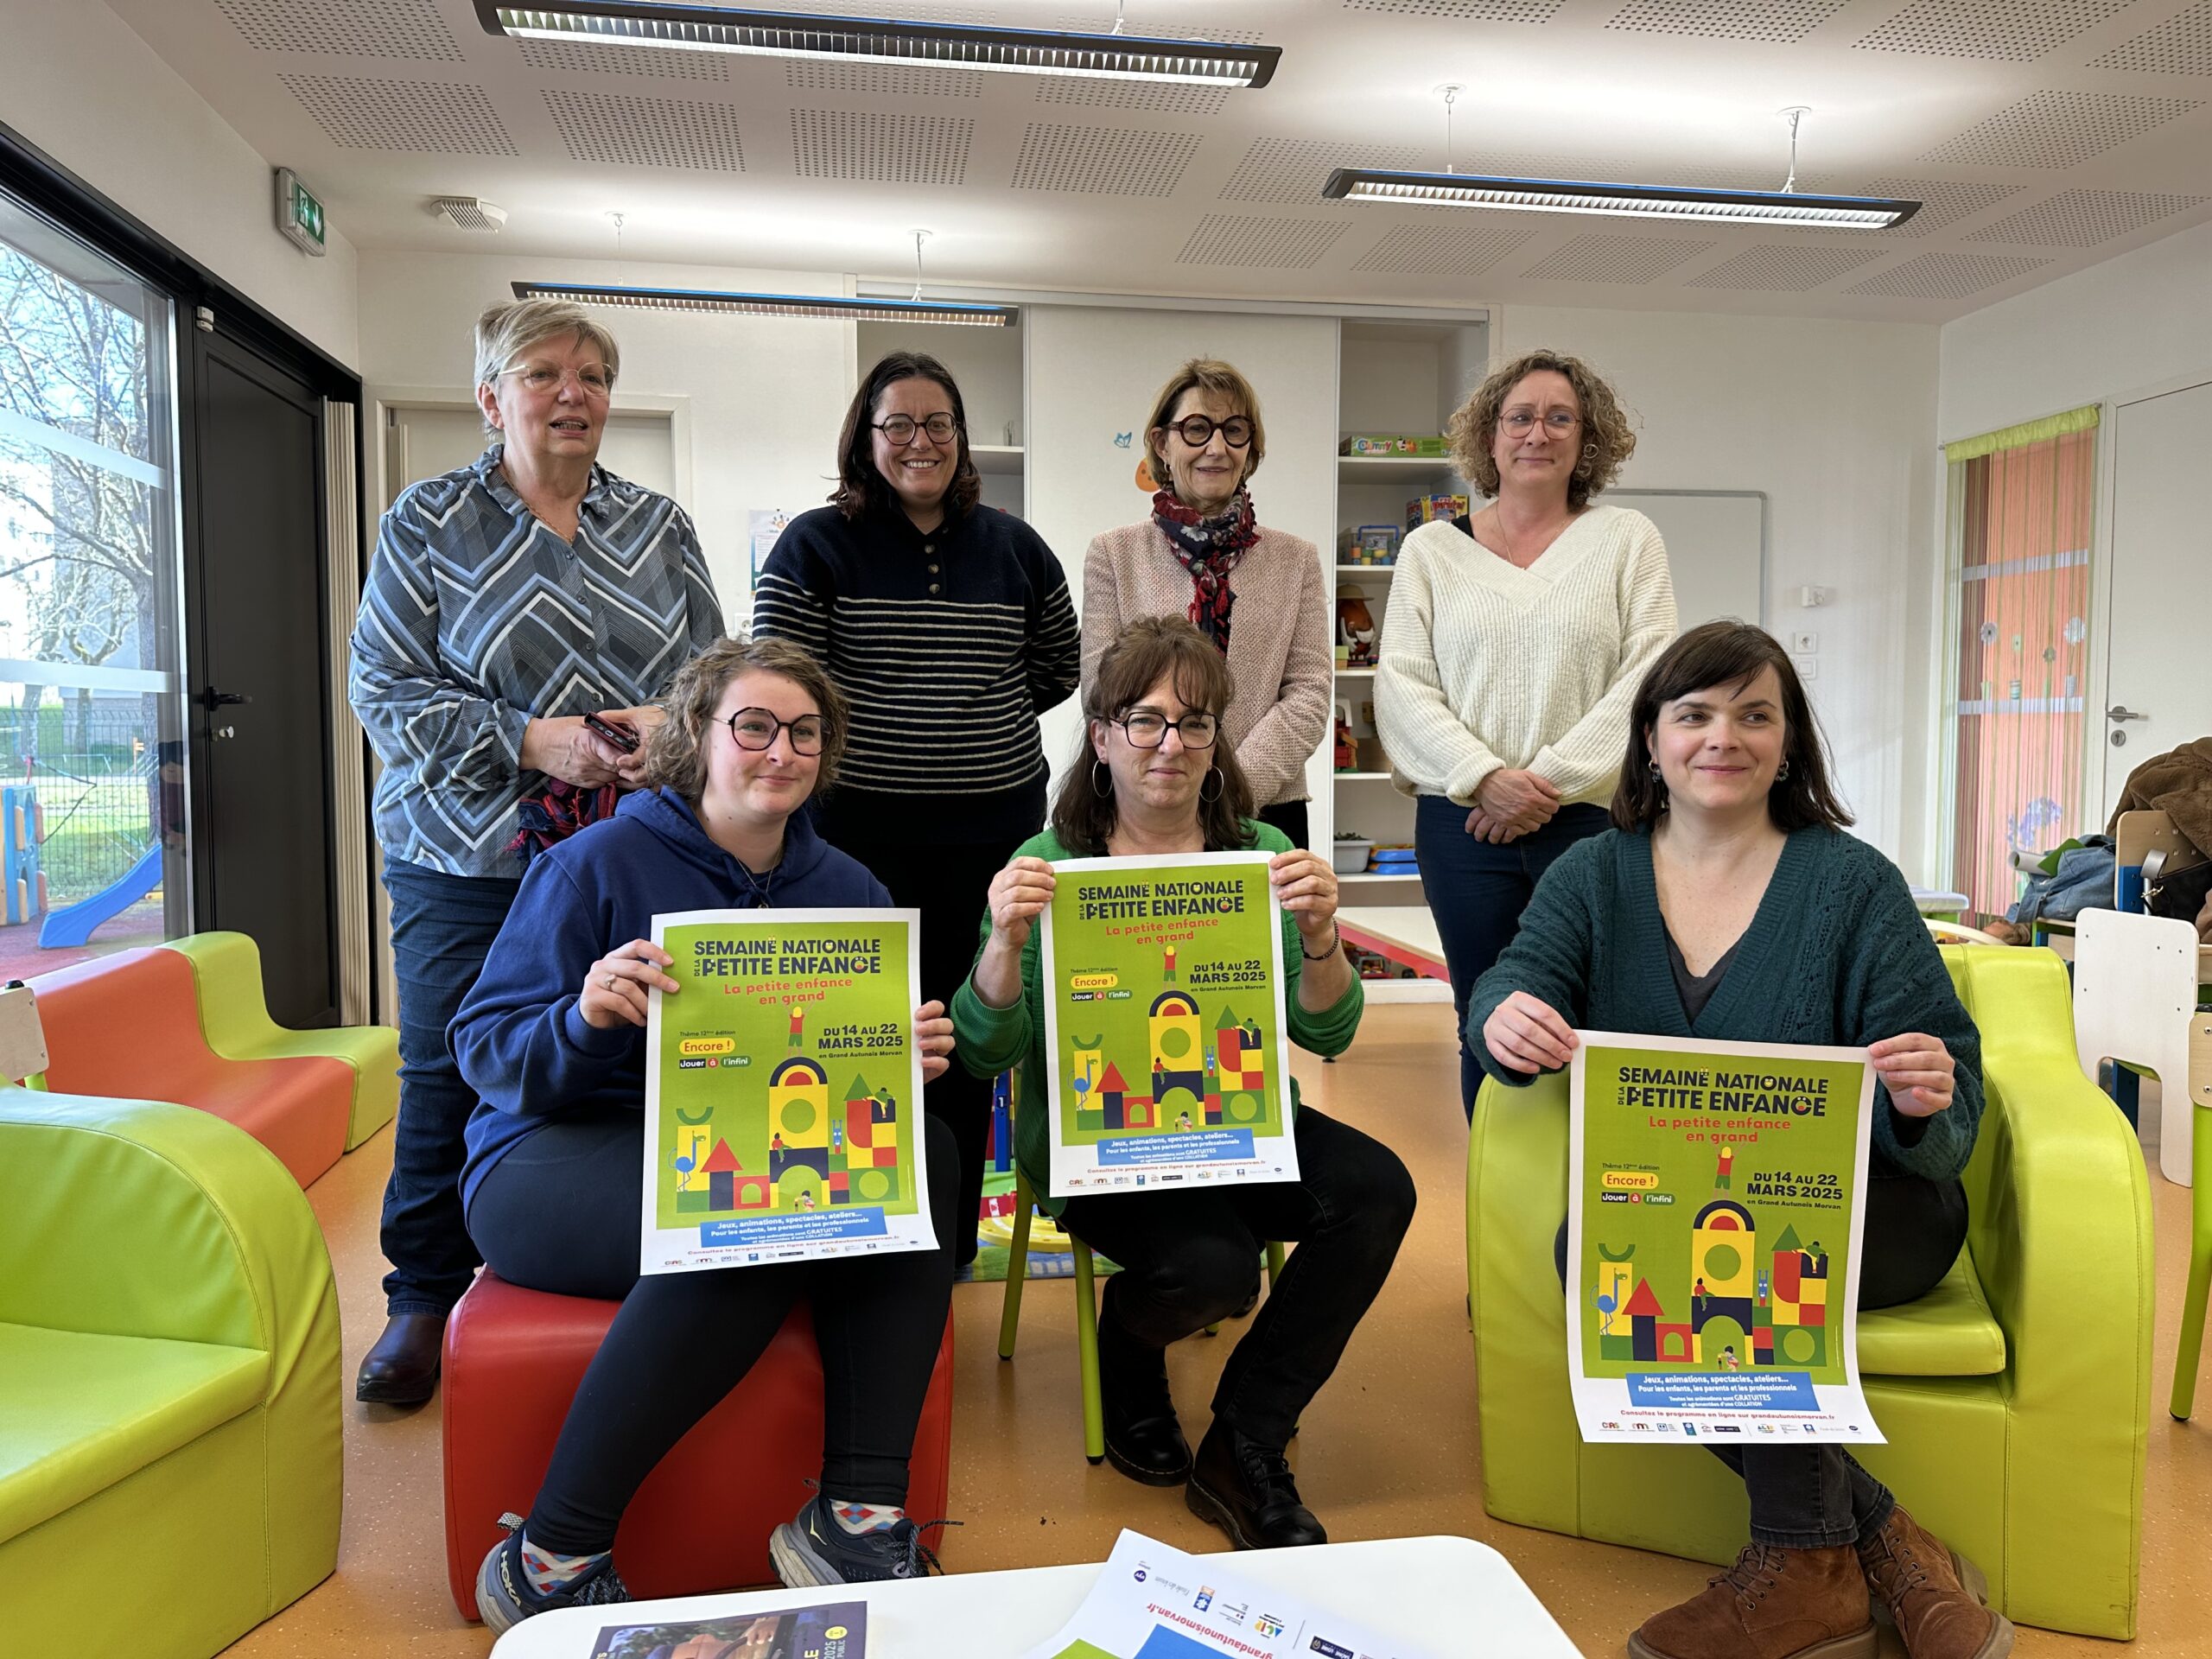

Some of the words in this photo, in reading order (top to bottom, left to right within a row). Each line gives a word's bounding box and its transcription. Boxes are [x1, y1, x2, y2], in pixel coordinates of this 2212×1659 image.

[1078, 885, 1150, 900] SEMAINE
[1155, 880, 1243, 897] NATIONALE
[1086, 900, 1147, 919] PETITE
[1152, 896, 1244, 916] ENFANCE
[1106, 926, 1120, 936] La
[1125, 922, 1163, 936] petite
[1168, 918, 1218, 930] enfance
[1156, 931, 1194, 944] grand
[695, 940, 776, 955] SEMAINE
[783, 939, 880, 954] NATIONALE
[702, 957, 772, 976] PETITE
[779, 956, 880, 975] ENFANCE
[1211, 962, 1224, 971] 14
[1244, 960, 1261, 969] 22
[1075, 978, 1108, 987] Encore
[1110, 976, 1113, 985] !
[1190, 973, 1230, 983] MARS
[1233, 971, 1266, 982] 2025
[724, 984, 741, 994] La
[747, 981, 790, 995] petite
[796, 978, 852, 988] enfance
[760, 995, 777, 1004] en
[782, 991, 824, 1005] grand
[842, 1025, 857, 1035] 14
[880, 1023, 897, 1033] 22
[684, 1041, 723, 1052] Encore
[727, 1040, 730, 1050] !
[818, 1037, 863, 1049] MARS
[867, 1036, 903, 1047] 2025
[1618, 1066, 1709, 1087] SEMAINE
[1715, 1072, 1828, 1094] NATIONALE
[999, 1096, 1004, 1107] 1
[1618, 1096, 1624, 1105] DE
[1626, 1087, 1703, 1109] PETITE
[1709, 1090, 1827, 1116] ENFANCE
[1649, 1116, 1666, 1127] La
[1673, 1116, 1720, 1129] petite
[1727, 1117, 1790, 1128] enfance
[1167, 1135, 1204, 1143] spectacles,
[1711, 1132, 1758, 1144] grand
[1607, 1174, 1646, 1185] Encore
[1650, 1176, 1654, 1186] !
[1754, 1173, 1771, 1181] DU
[1775, 1172, 1791, 1183] 14
[1796, 1175, 1813, 1184] AU
[1817, 1174, 1837, 1185] 22
[1747, 1183, 1797, 1197] MARS
[1801, 1186, 1842, 1199] 2025
[785, 1214, 827, 1223] spectacles,
[1643, 1376, 1663, 1384] Jeux,
[1665, 1376, 1709, 1384] animations,
[1711, 1375, 1753, 1384] spectacles,
[501, 1550, 521, 1607] HOKA
[1146, 1603, 1274, 1659] grandautunoismorvan.fr
[823, 1641, 836, 1659] 2025
